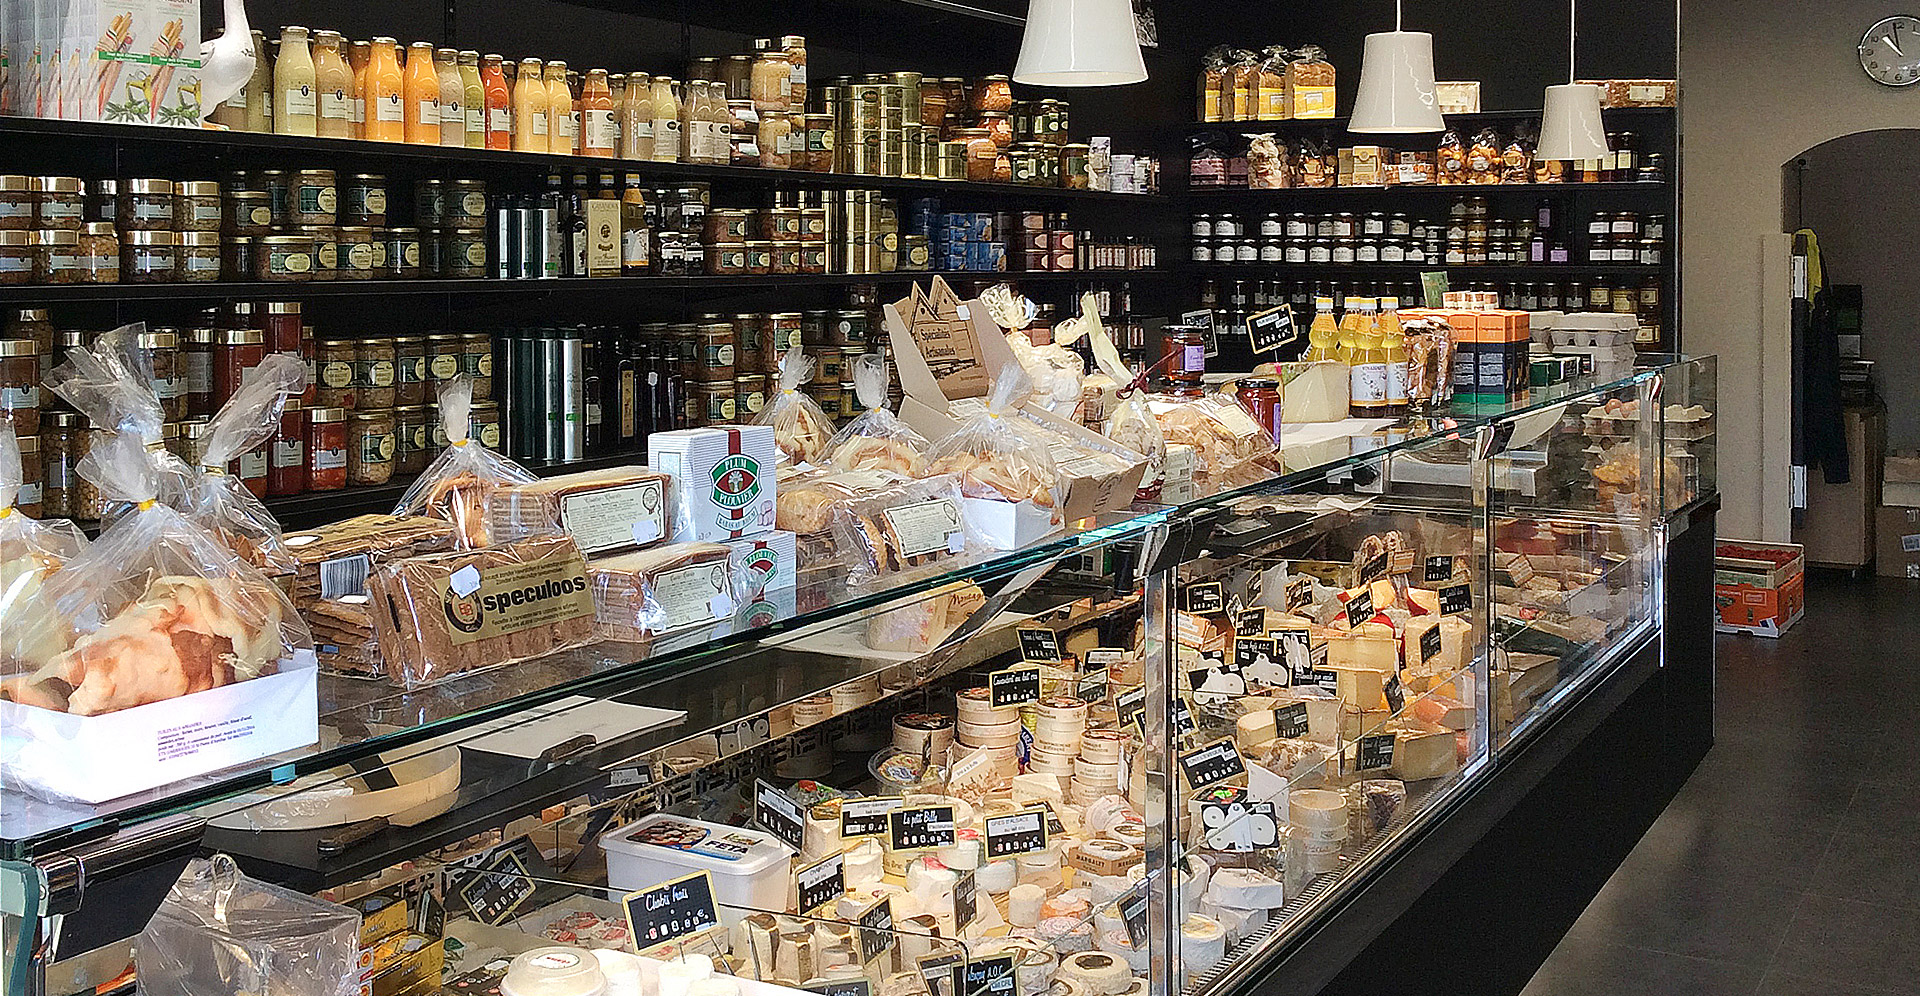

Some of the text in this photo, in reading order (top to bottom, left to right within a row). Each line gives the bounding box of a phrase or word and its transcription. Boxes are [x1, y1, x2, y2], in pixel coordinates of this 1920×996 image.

[724, 457, 748, 470] PLUM
[719, 490, 755, 506] PLOUVIER
[483, 576, 586, 613] speculoos
[902, 811, 911, 825] Le
[704, 840, 749, 855] FETA
